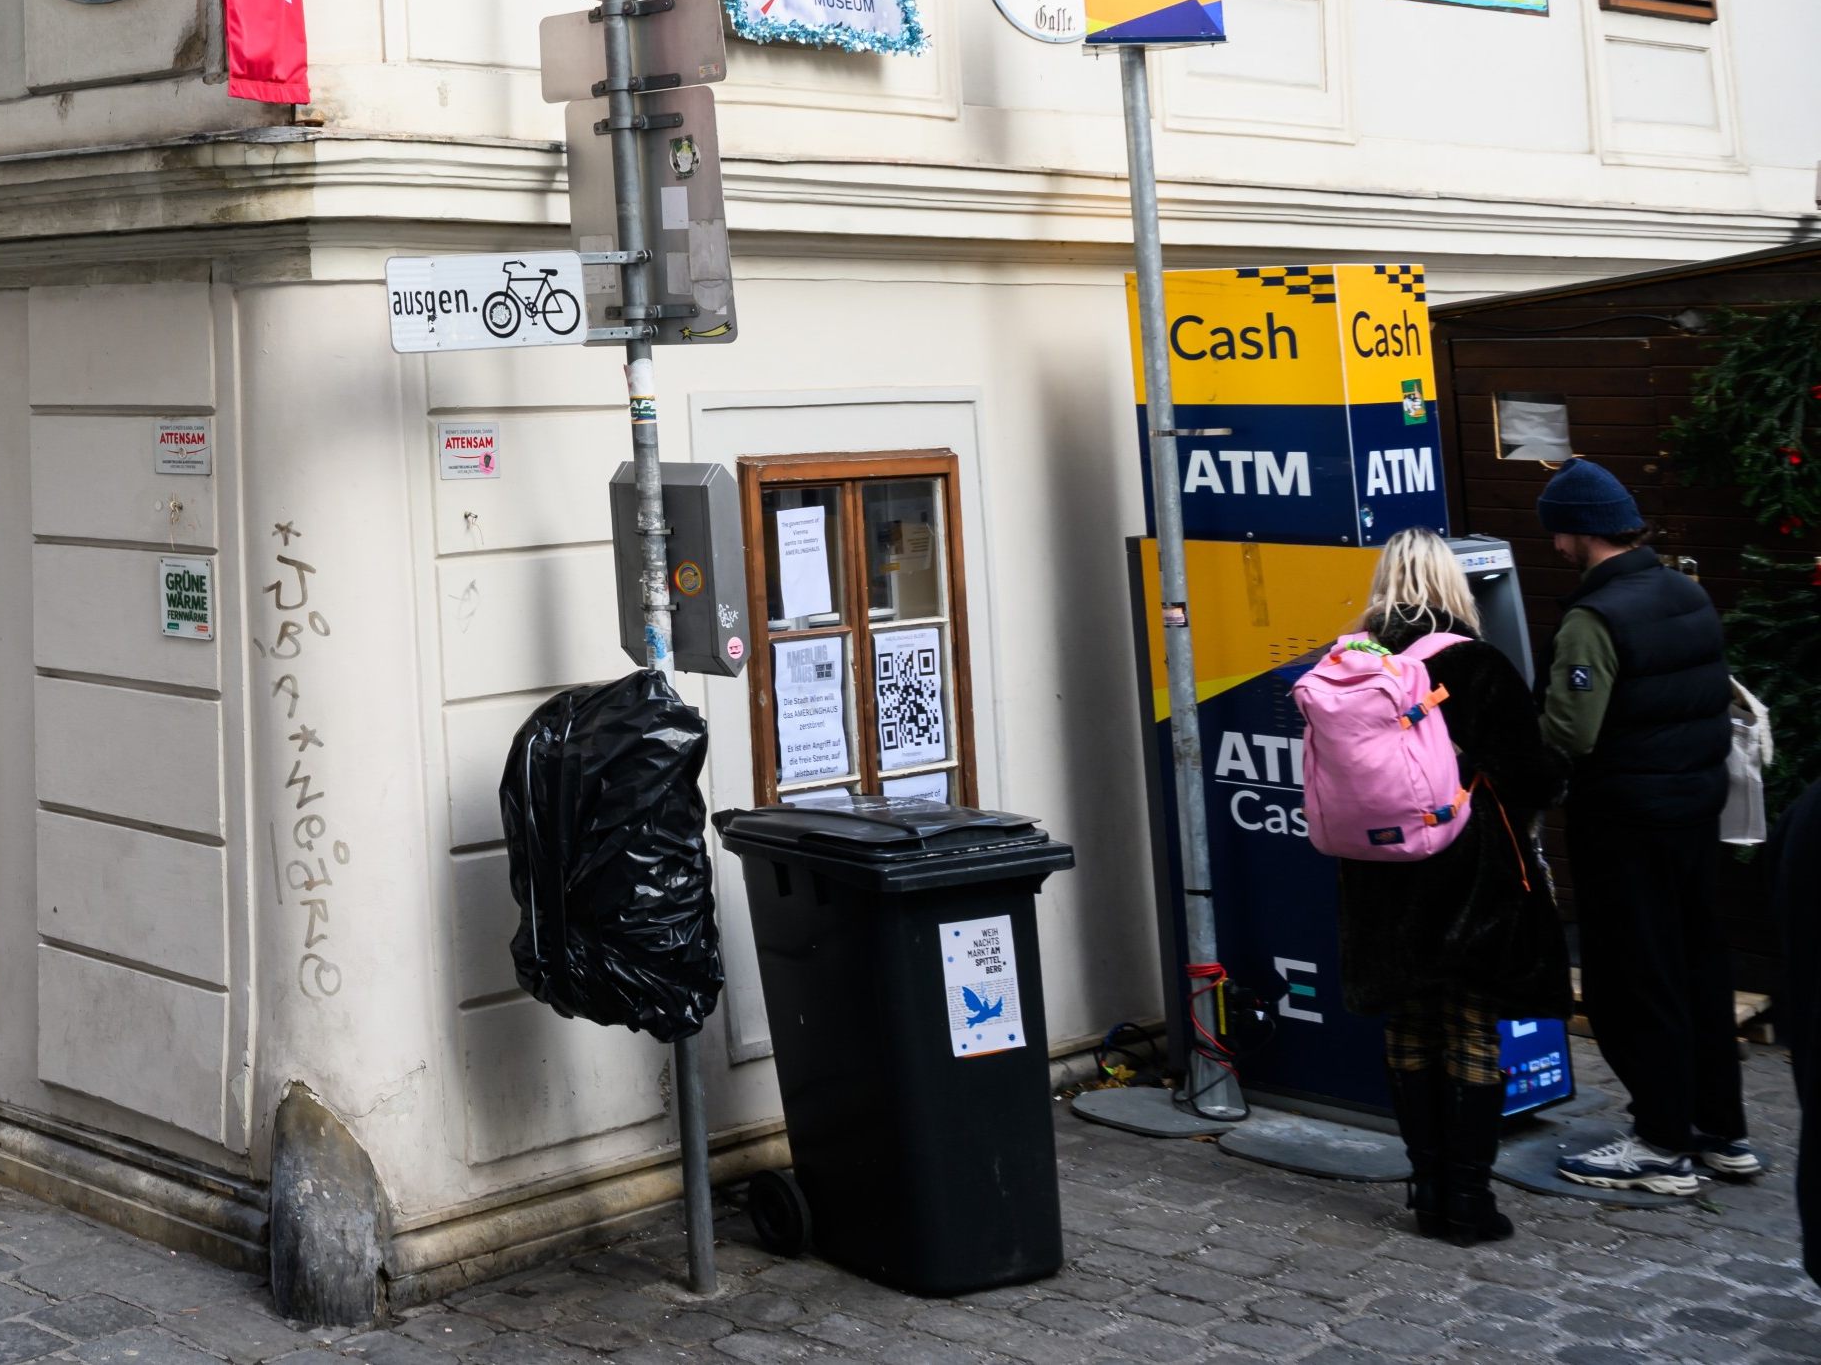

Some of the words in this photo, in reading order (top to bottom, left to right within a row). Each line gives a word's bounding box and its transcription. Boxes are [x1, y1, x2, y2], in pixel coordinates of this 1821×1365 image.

[392, 287, 479, 322] ausgen.
[1169, 311, 1299, 362] Cash
[1352, 309, 1423, 359] Cash
[159, 432, 205, 445] ATTENSAM
[444, 436, 494, 450] ATTENSAM
[1183, 449, 1312, 497] ATM
[1366, 447, 1436, 497] ATM
[165, 569, 208, 594] GRÜNE
[166, 591, 208, 612] WÄRME
[167, 609, 209, 624] FERNWÄRME
[1229, 790, 1310, 838] Cas
[972, 936, 1000, 948] NACHTS
[981, 927, 999, 937] WEIH
[966, 947, 989, 959] MARKT
[990, 946, 1001, 955] AM
[975, 955, 1002, 967] SPITTEL
